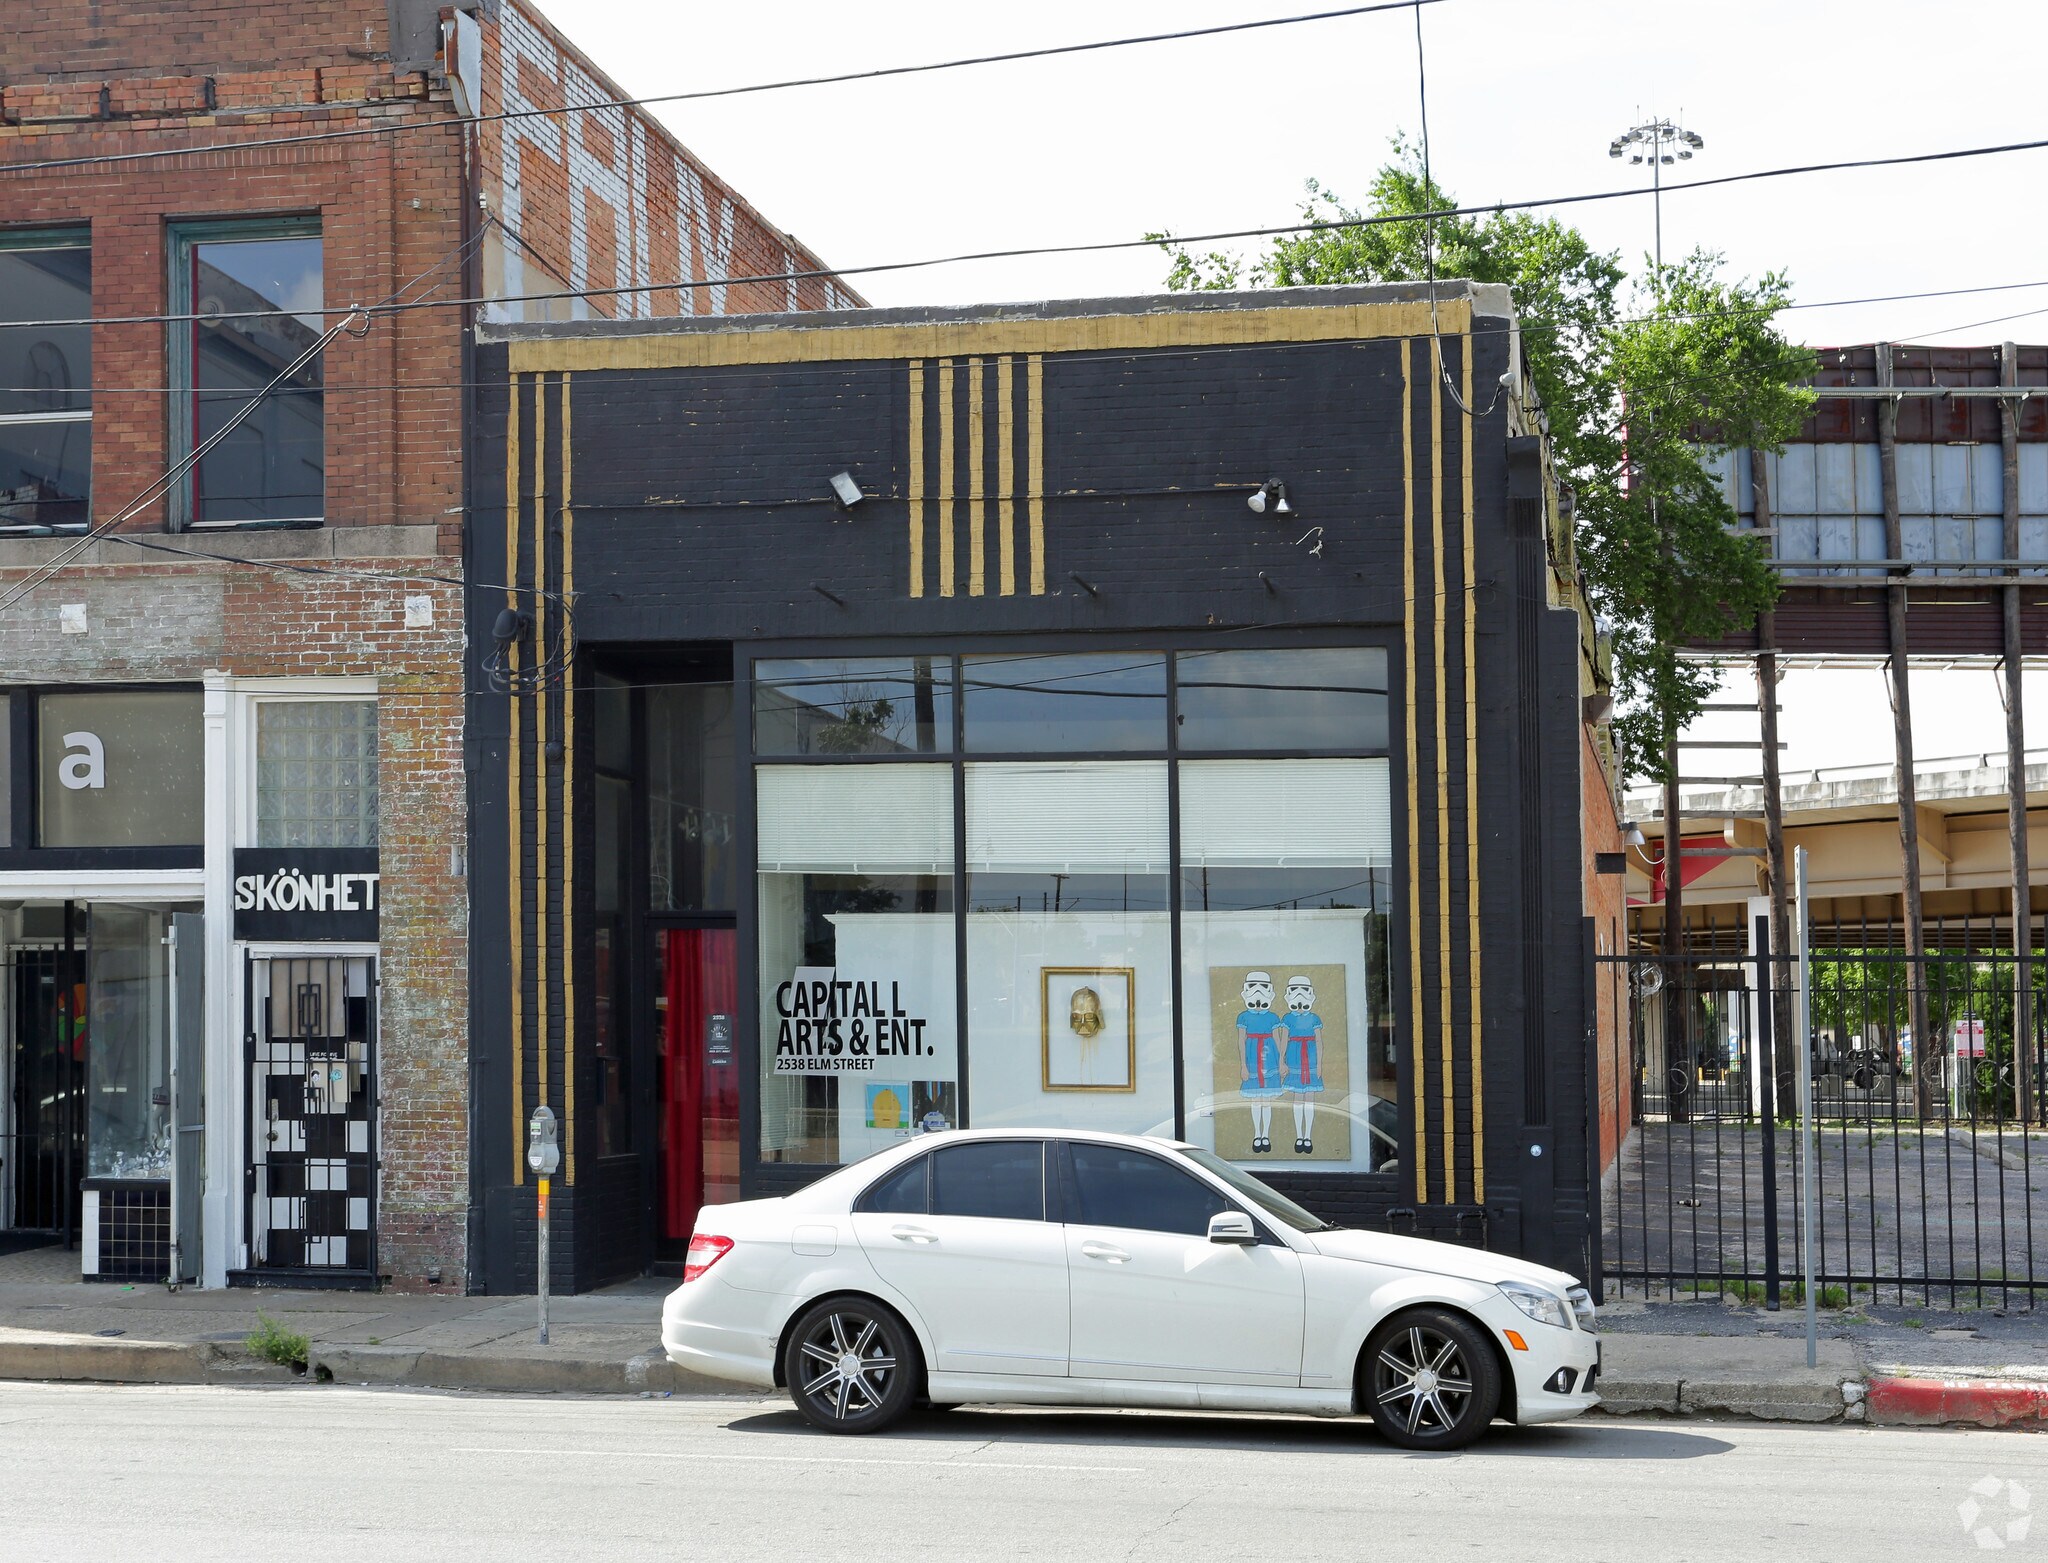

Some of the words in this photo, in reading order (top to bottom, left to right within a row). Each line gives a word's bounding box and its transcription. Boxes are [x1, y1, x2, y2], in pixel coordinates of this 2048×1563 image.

[58, 731, 105, 790] a
[234, 867, 380, 912] SKÖNHET
[776, 1019, 844, 1056] ARTS
[849, 1019, 869, 1056] &
[876, 1019, 934, 1056] ENT.
[777, 1058, 805, 1070] 2538
[807, 1058, 831, 1070] ELM
[833, 1058, 875, 1070] STREET
[1943, 1381, 1970, 1389] NO
